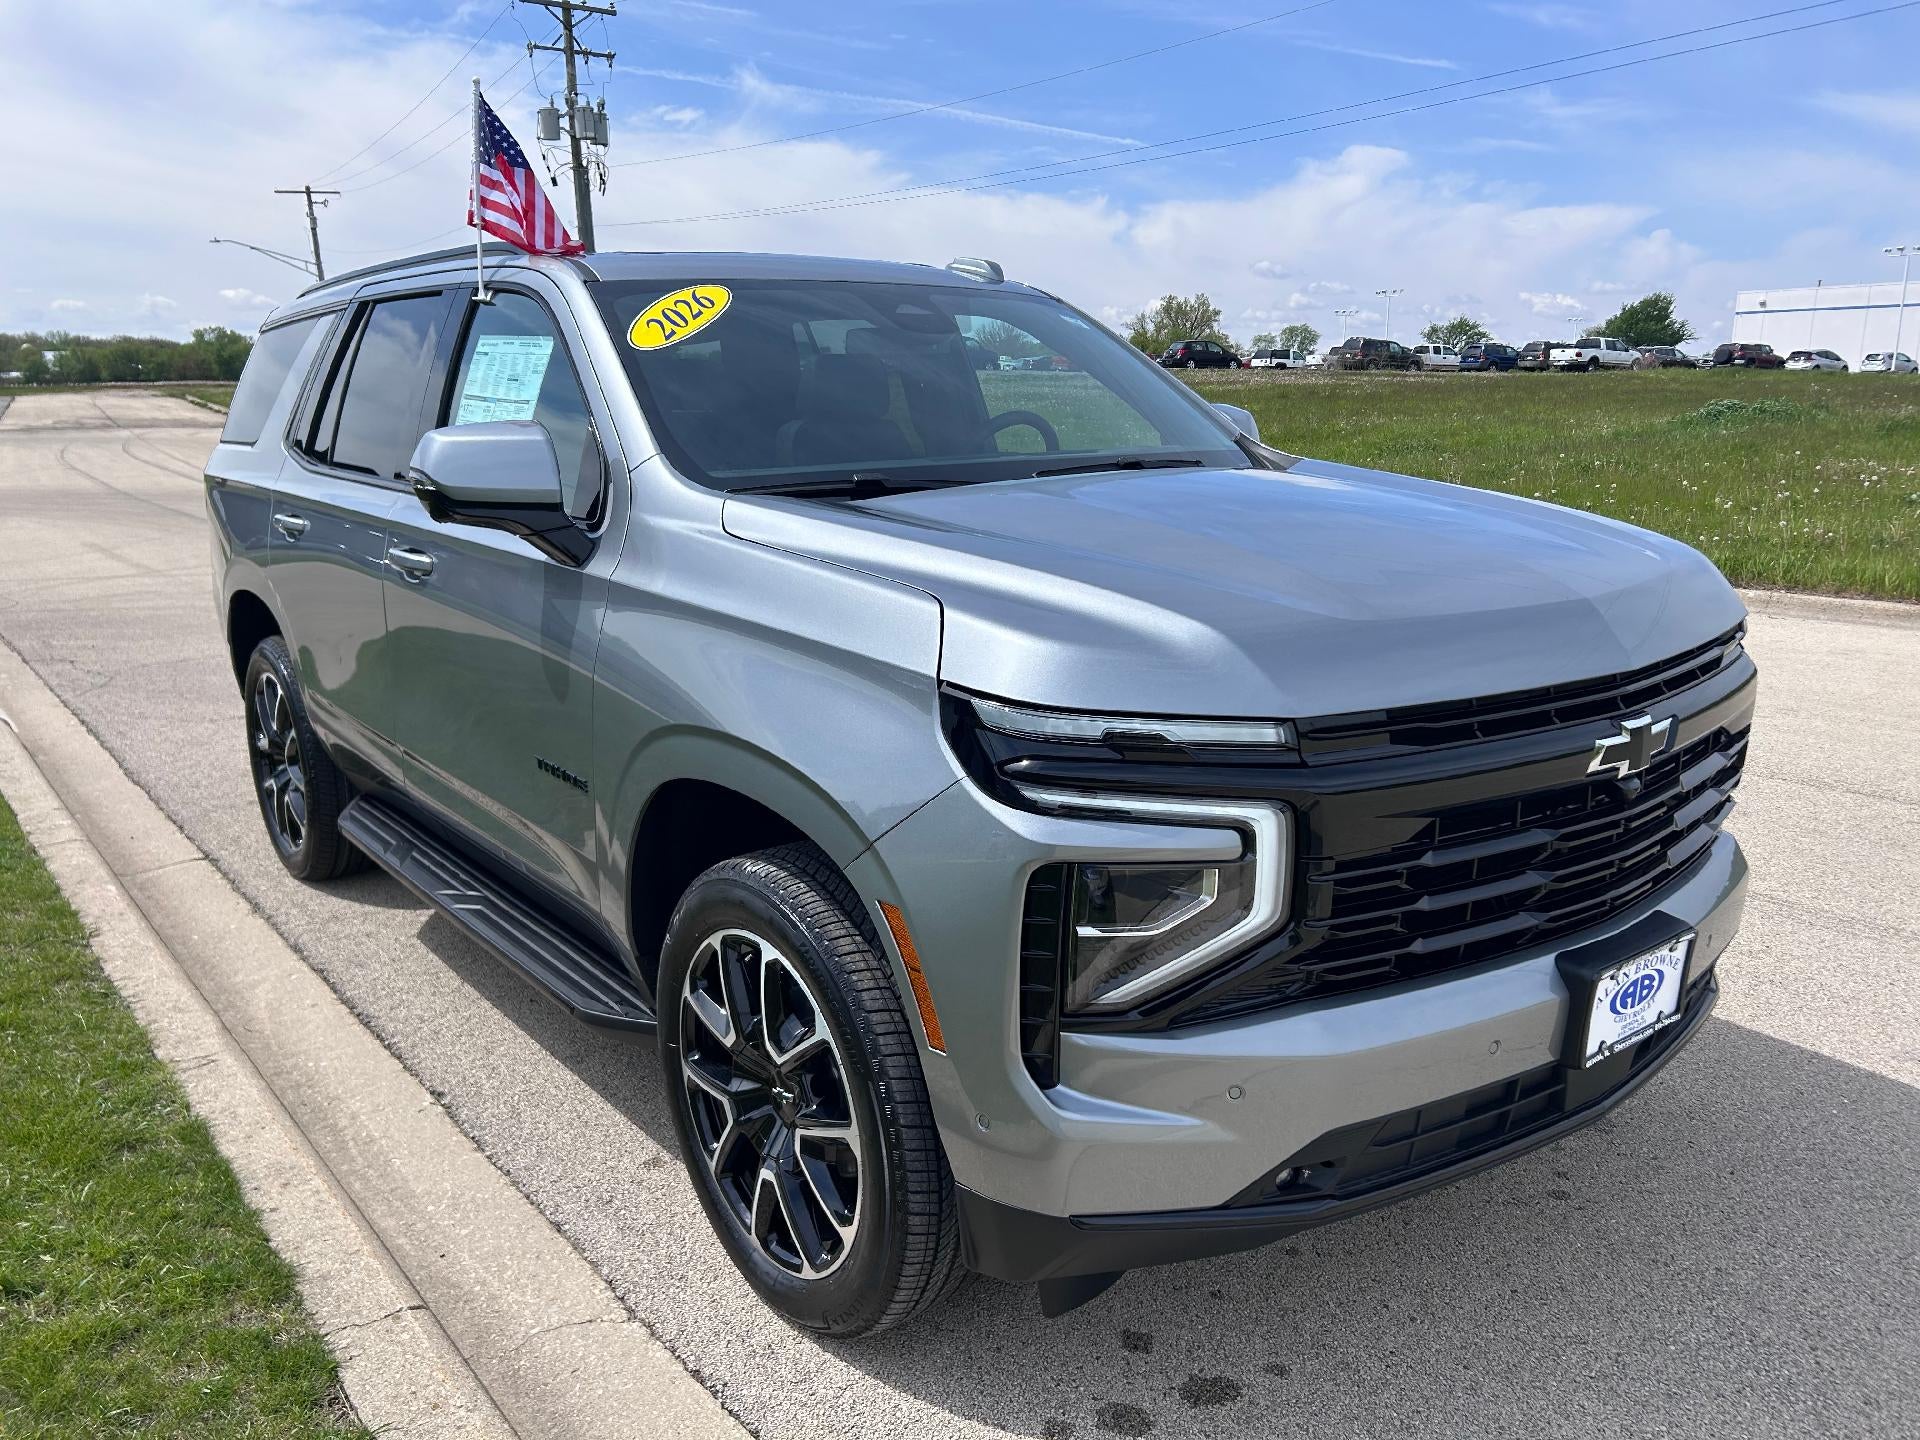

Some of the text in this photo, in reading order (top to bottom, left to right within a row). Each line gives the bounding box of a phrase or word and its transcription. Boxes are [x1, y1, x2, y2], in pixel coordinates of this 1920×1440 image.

[646, 289, 715, 341] 2026
[1635, 953, 1680, 974] BROWNE
[1619, 973, 1656, 1010] AB
[1613, 998, 1656, 1023] CHEVROLET
